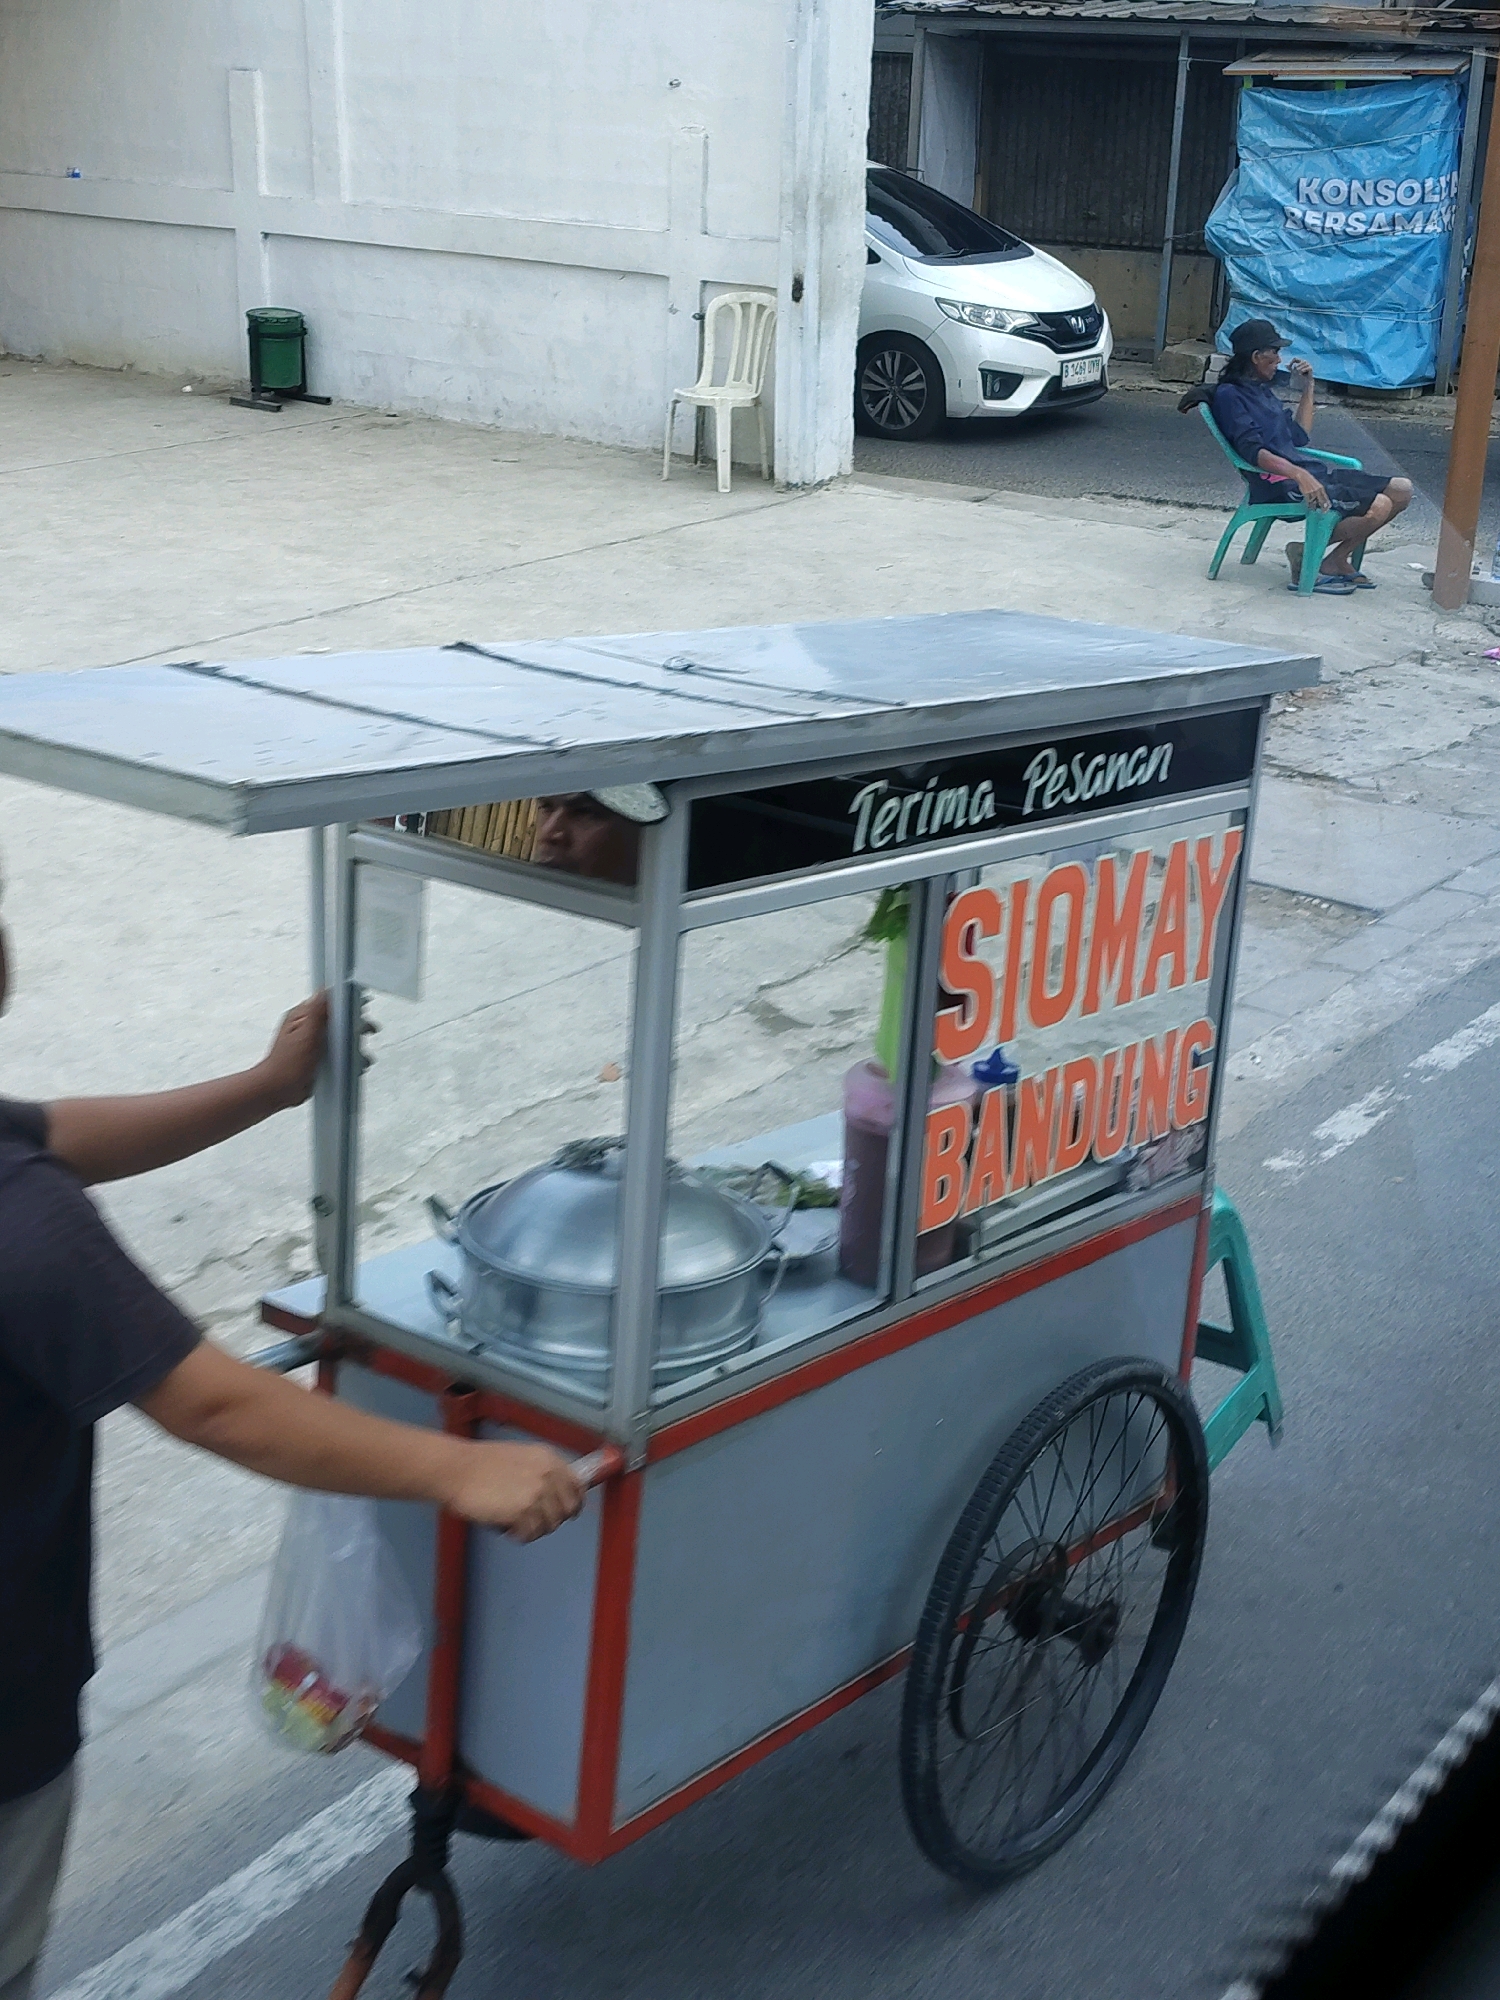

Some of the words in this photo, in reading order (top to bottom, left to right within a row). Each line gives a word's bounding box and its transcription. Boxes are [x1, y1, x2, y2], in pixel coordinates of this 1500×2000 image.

[1064, 364, 1070, 378] B
[848, 776, 997, 853] Terima
[932, 825, 1245, 1067] SIOMAY
[917, 1017, 1217, 1237] BANDUNG
